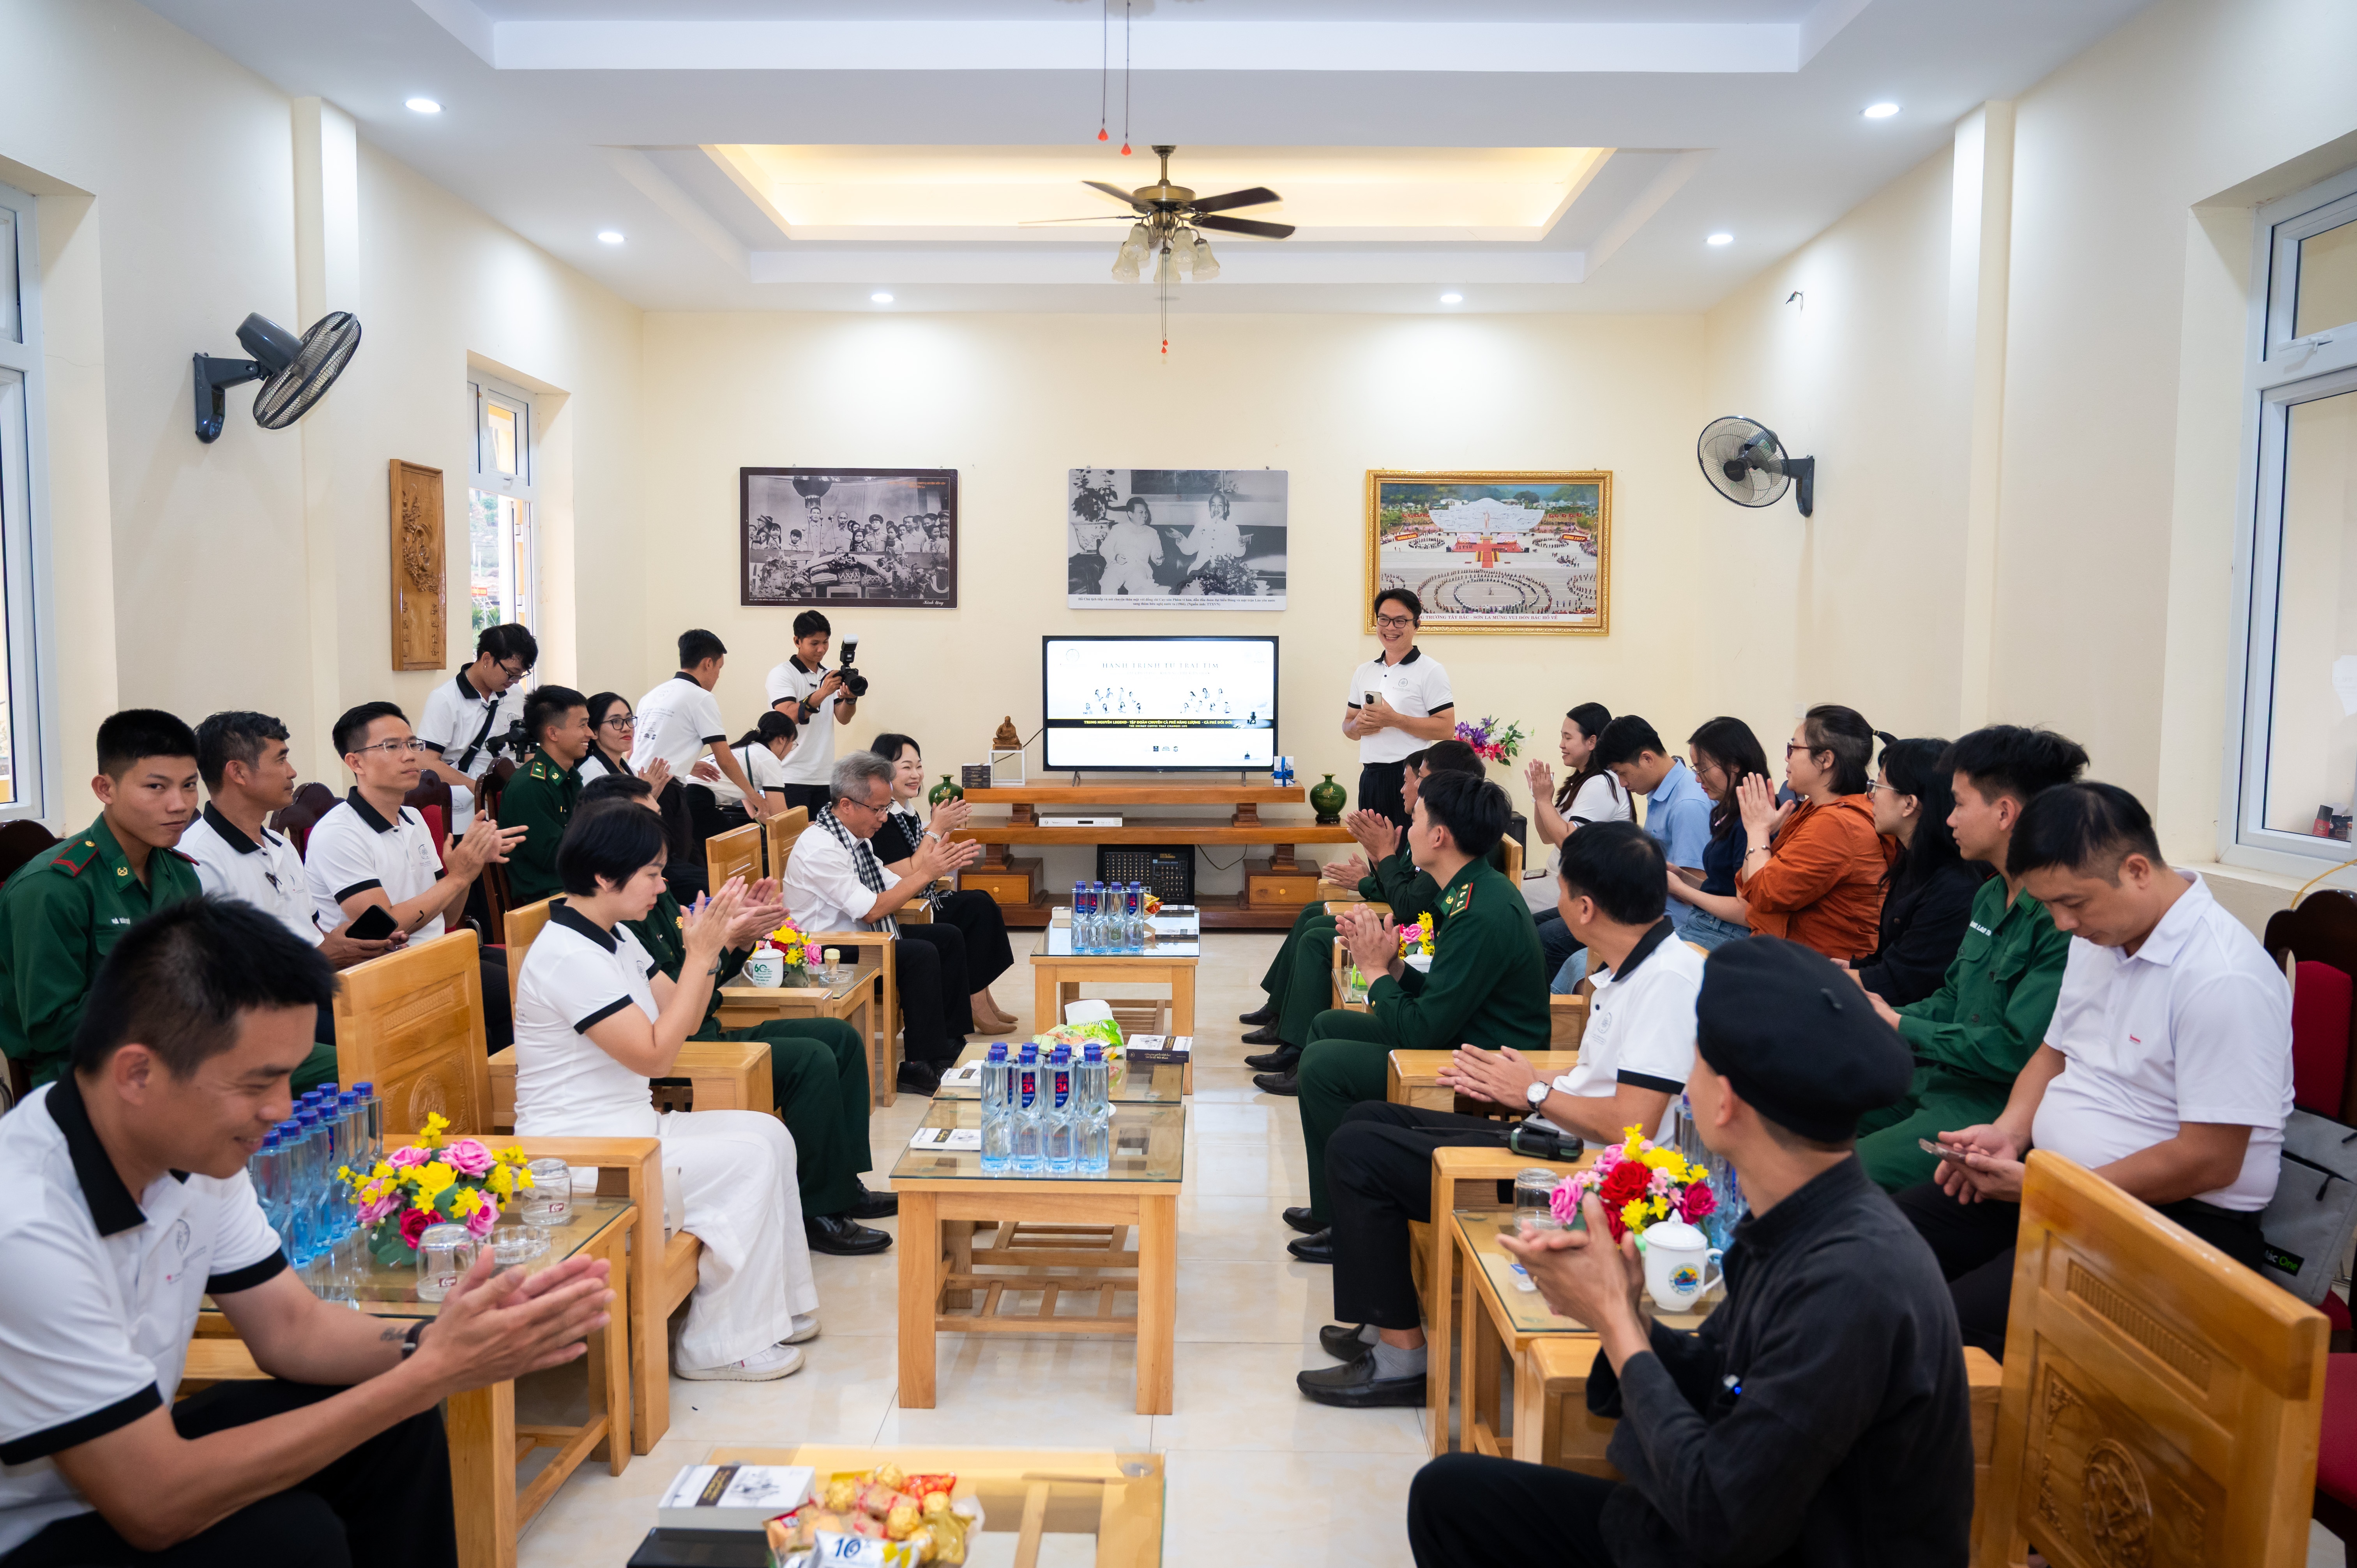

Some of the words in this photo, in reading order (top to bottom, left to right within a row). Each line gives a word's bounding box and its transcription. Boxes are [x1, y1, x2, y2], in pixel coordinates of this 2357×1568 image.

[1023, 1083, 1035, 1093] 3A
[1056, 1083, 1068, 1093] 3A
[2279, 1256, 2299, 1271] One
